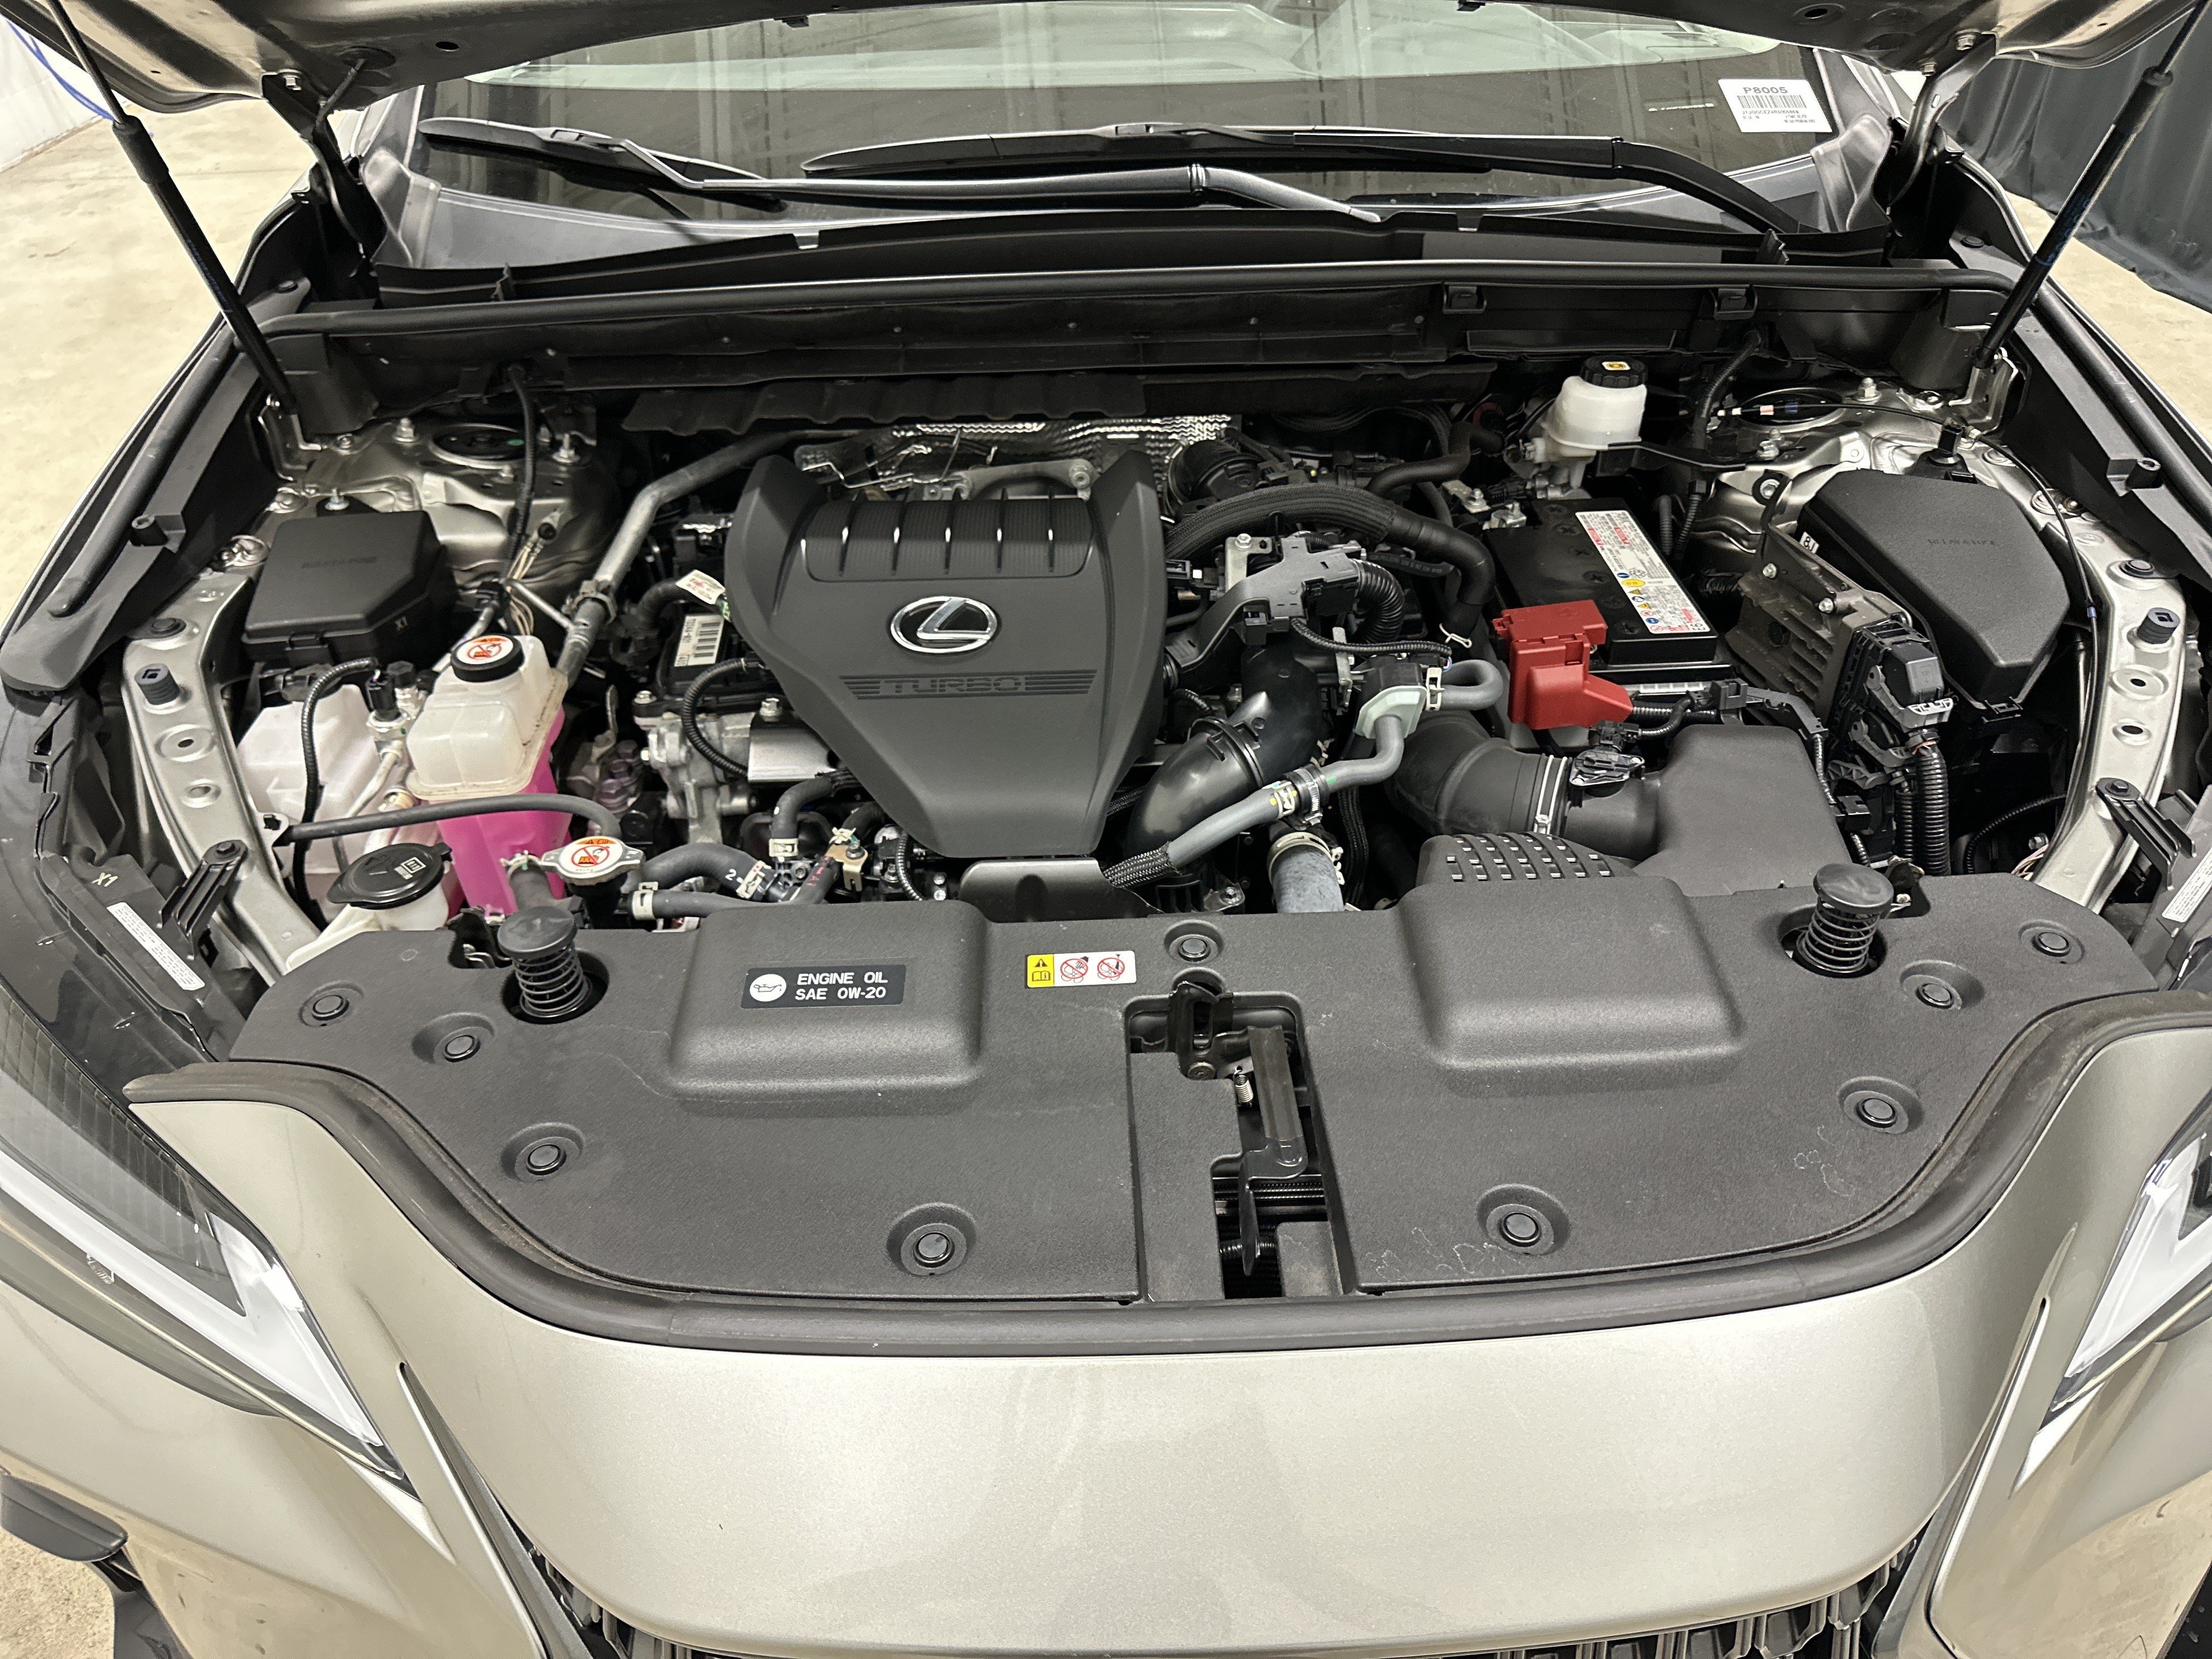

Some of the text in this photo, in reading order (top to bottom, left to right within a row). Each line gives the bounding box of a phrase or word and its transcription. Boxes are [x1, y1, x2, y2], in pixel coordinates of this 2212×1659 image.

[884, 676, 1022, 694] TURBO
[797, 971, 888, 985] ENGINE OIL
[795, 986, 887, 1001] SAE 0W-20
